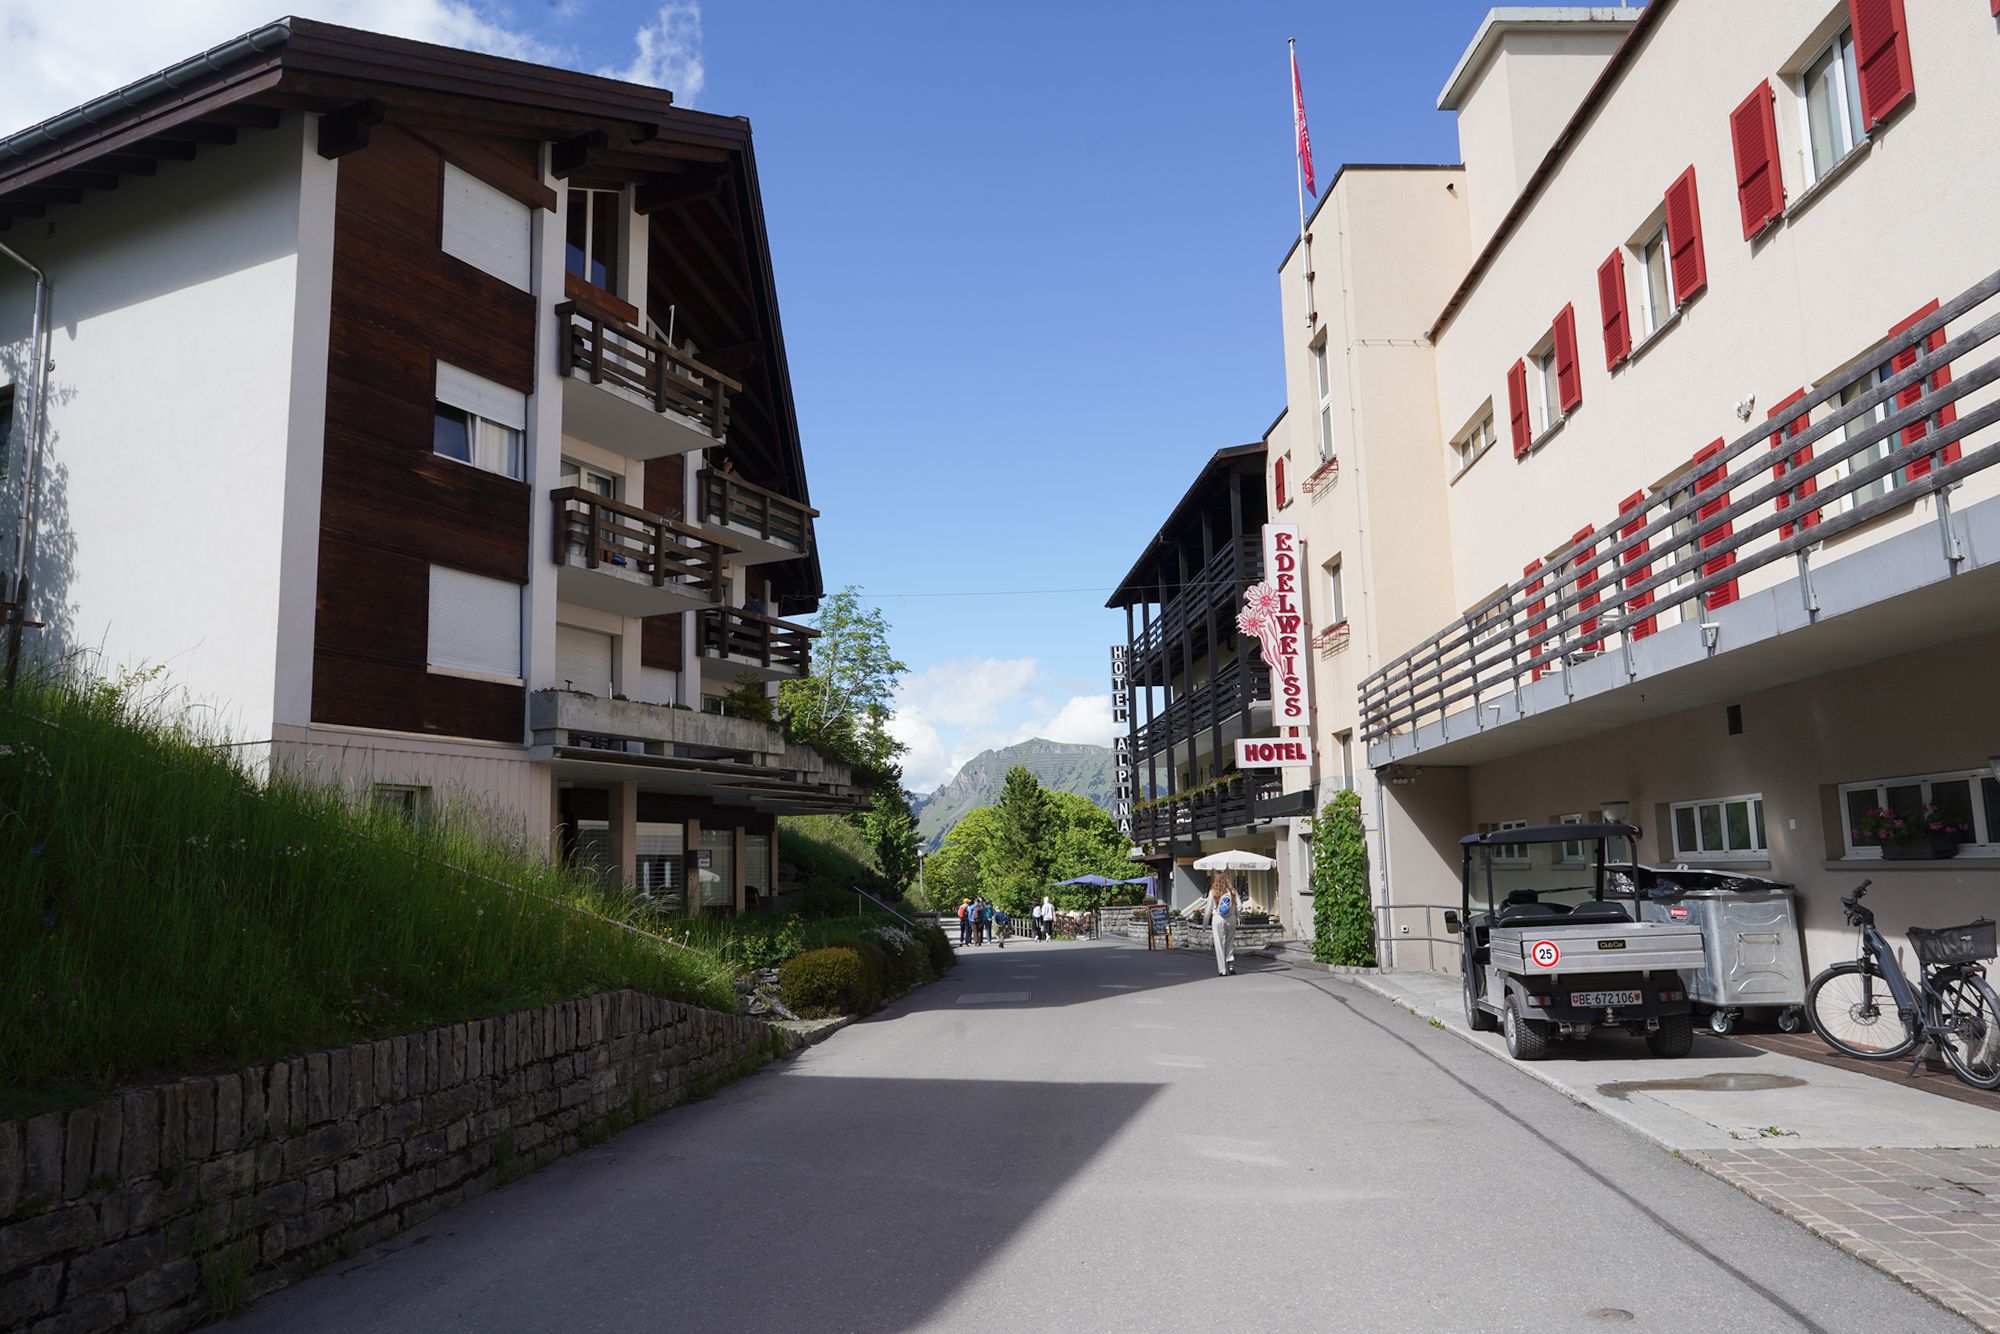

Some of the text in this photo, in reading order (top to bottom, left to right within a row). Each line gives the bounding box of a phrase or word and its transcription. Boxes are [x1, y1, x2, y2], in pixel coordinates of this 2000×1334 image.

[1275, 532, 1302, 717] EDELWEISS
[1113, 646, 1129, 831] HOTEL ALPINA
[1245, 743, 1307, 762] HOTEL
[1539, 949, 1553, 960] 25
